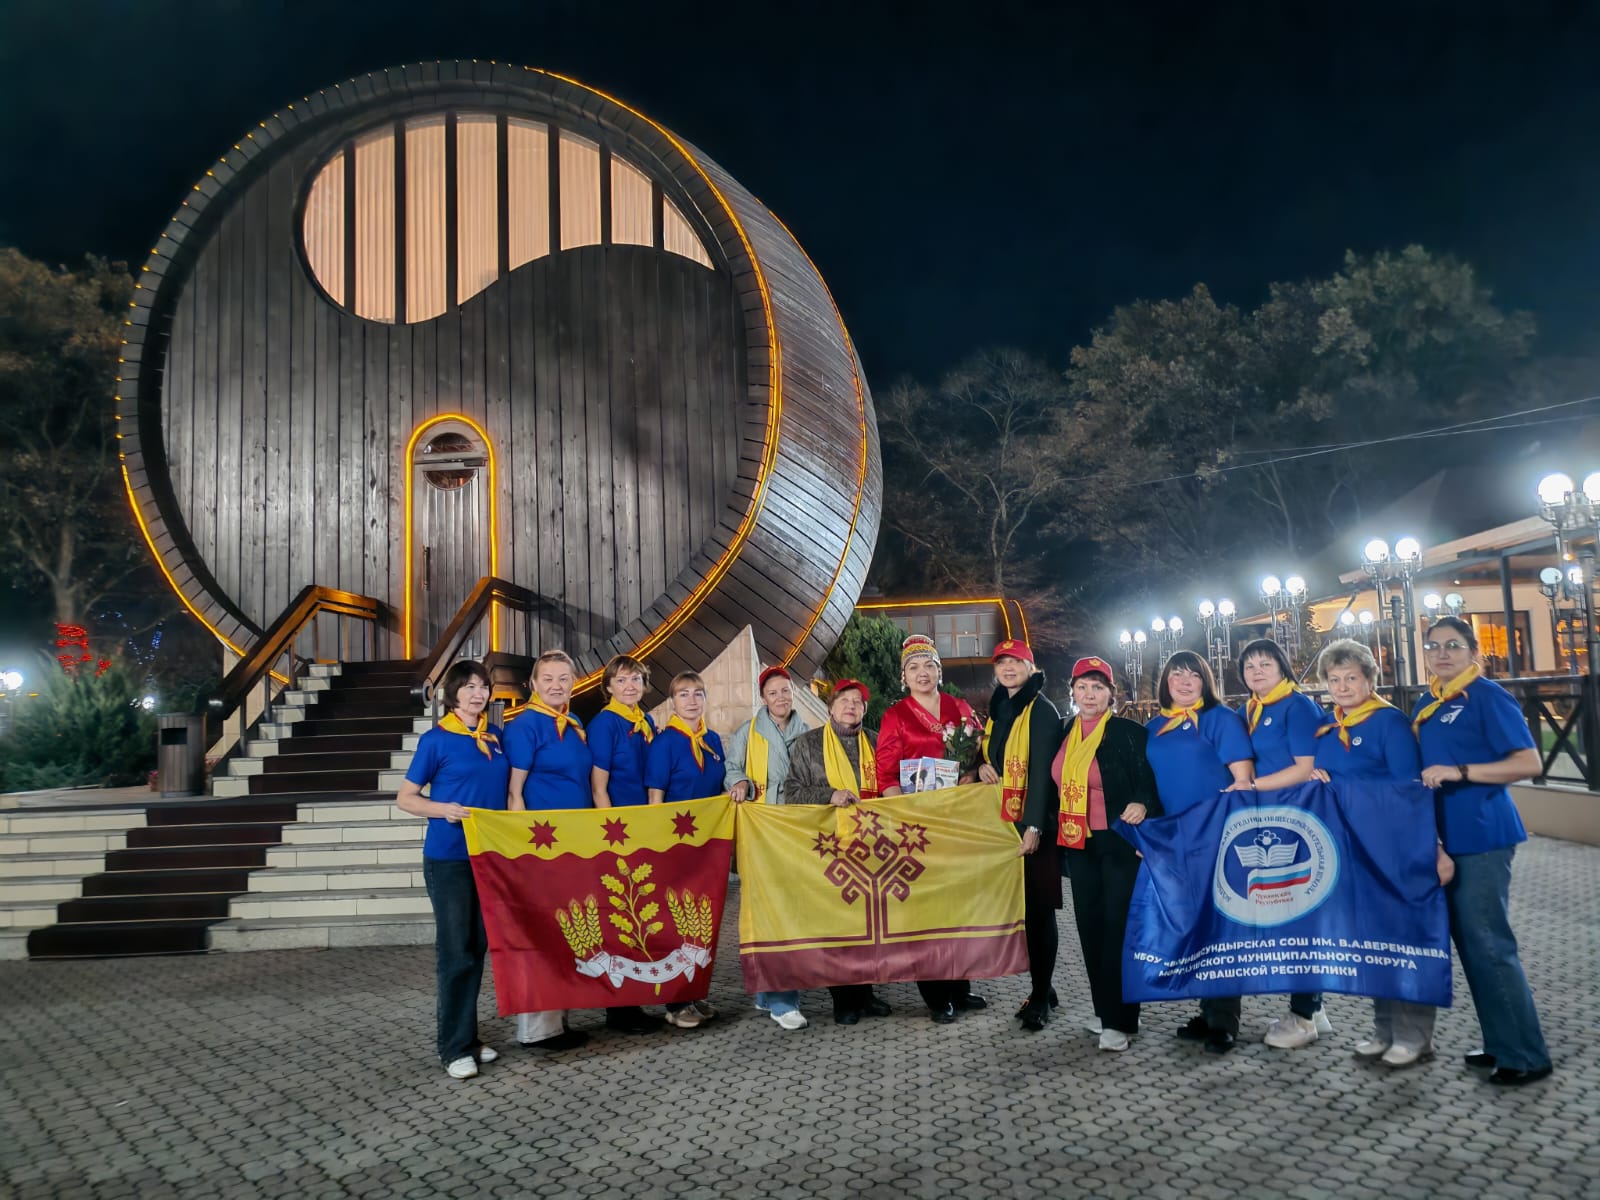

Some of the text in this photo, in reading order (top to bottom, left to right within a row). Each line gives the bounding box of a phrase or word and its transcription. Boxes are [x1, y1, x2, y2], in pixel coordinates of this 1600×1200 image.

[1133, 951, 1163, 964] МБОУ
[1279, 937, 1309, 947] СОШ
[1312, 937, 1336, 947] ИМ.
[1237, 950, 1362, 963] МУНИЦИПАЛЬНОГО
[1364, 954, 1418, 970] ОКРУГА
[1195, 964, 1358, 981] ЧУВАШСКОЙ РЕСПУБЛИКИ
